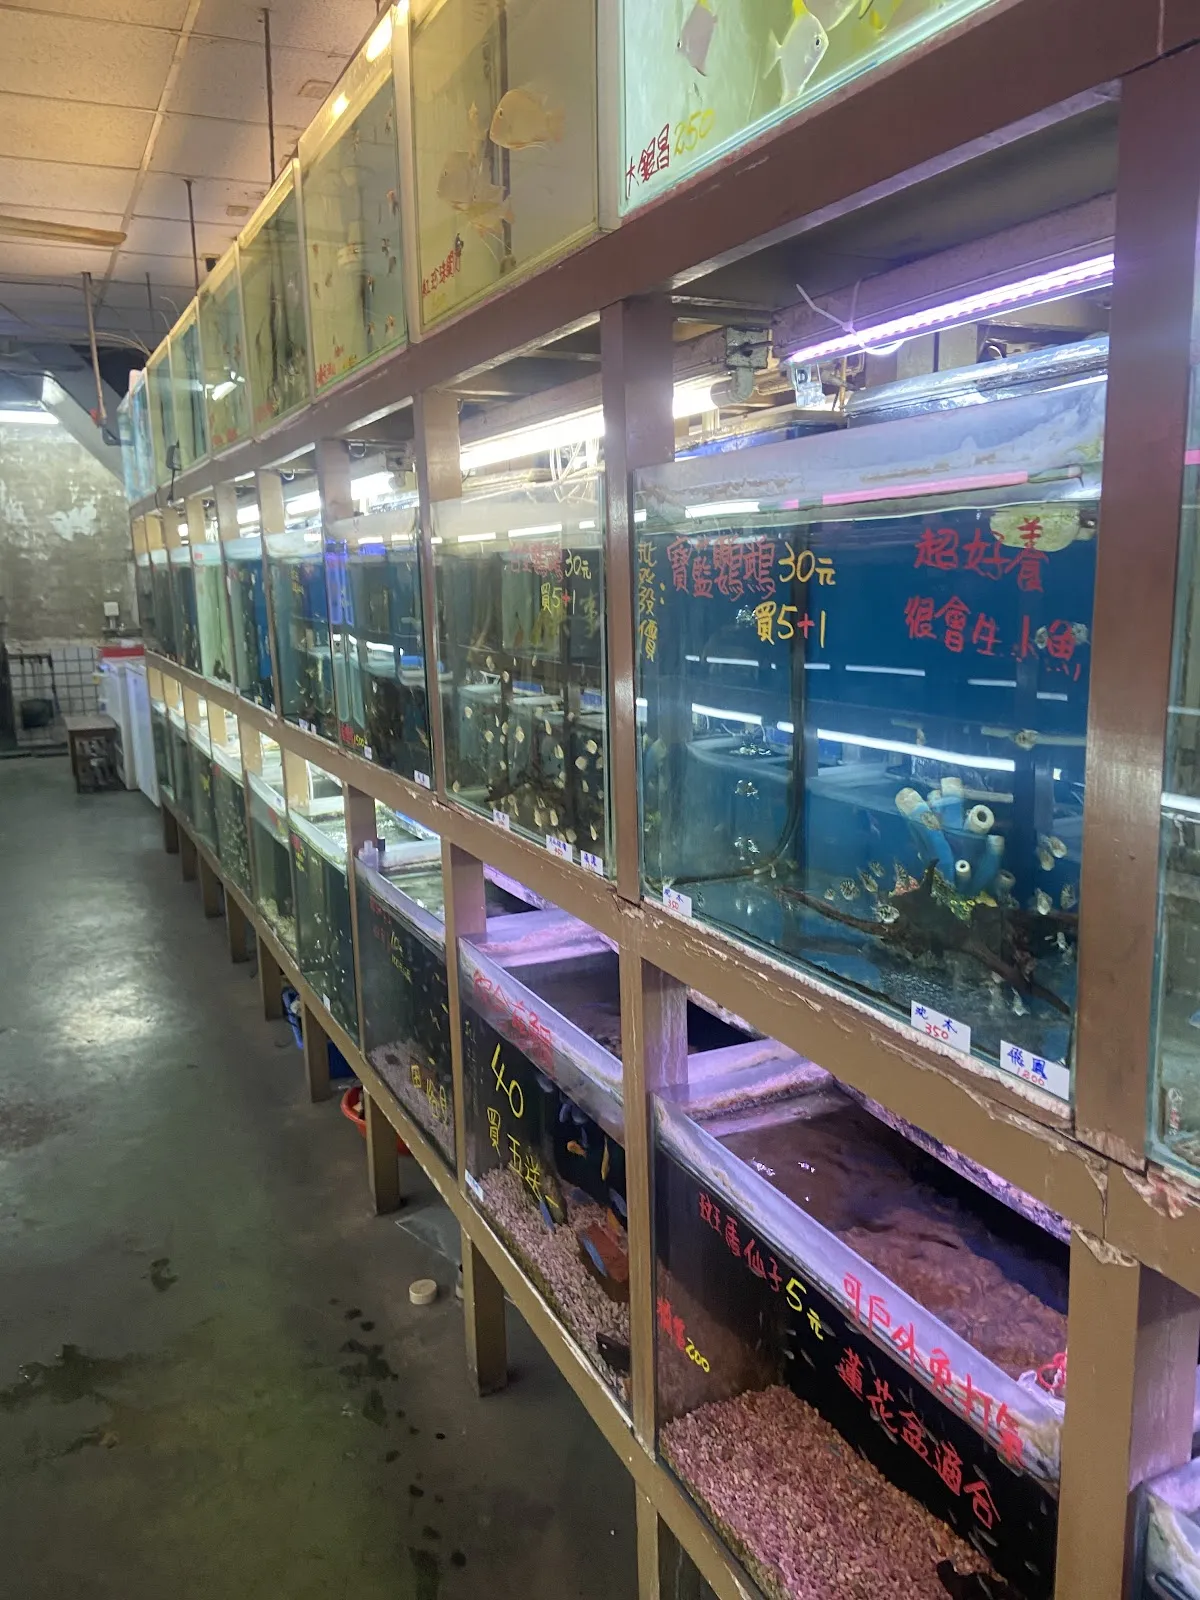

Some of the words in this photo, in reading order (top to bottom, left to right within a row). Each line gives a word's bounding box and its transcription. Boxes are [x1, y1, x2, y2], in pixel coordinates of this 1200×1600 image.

[674, 108, 716, 156] 250
[914, 516, 1049, 592] 超好養
[541, 582, 576, 615] 買5+1
[755, 601, 826, 648] 買5+1
[925, 1021, 949, 1040] 350
[491, 1043, 524, 1118] 40
[785, 1277, 824, 1341] 5元
